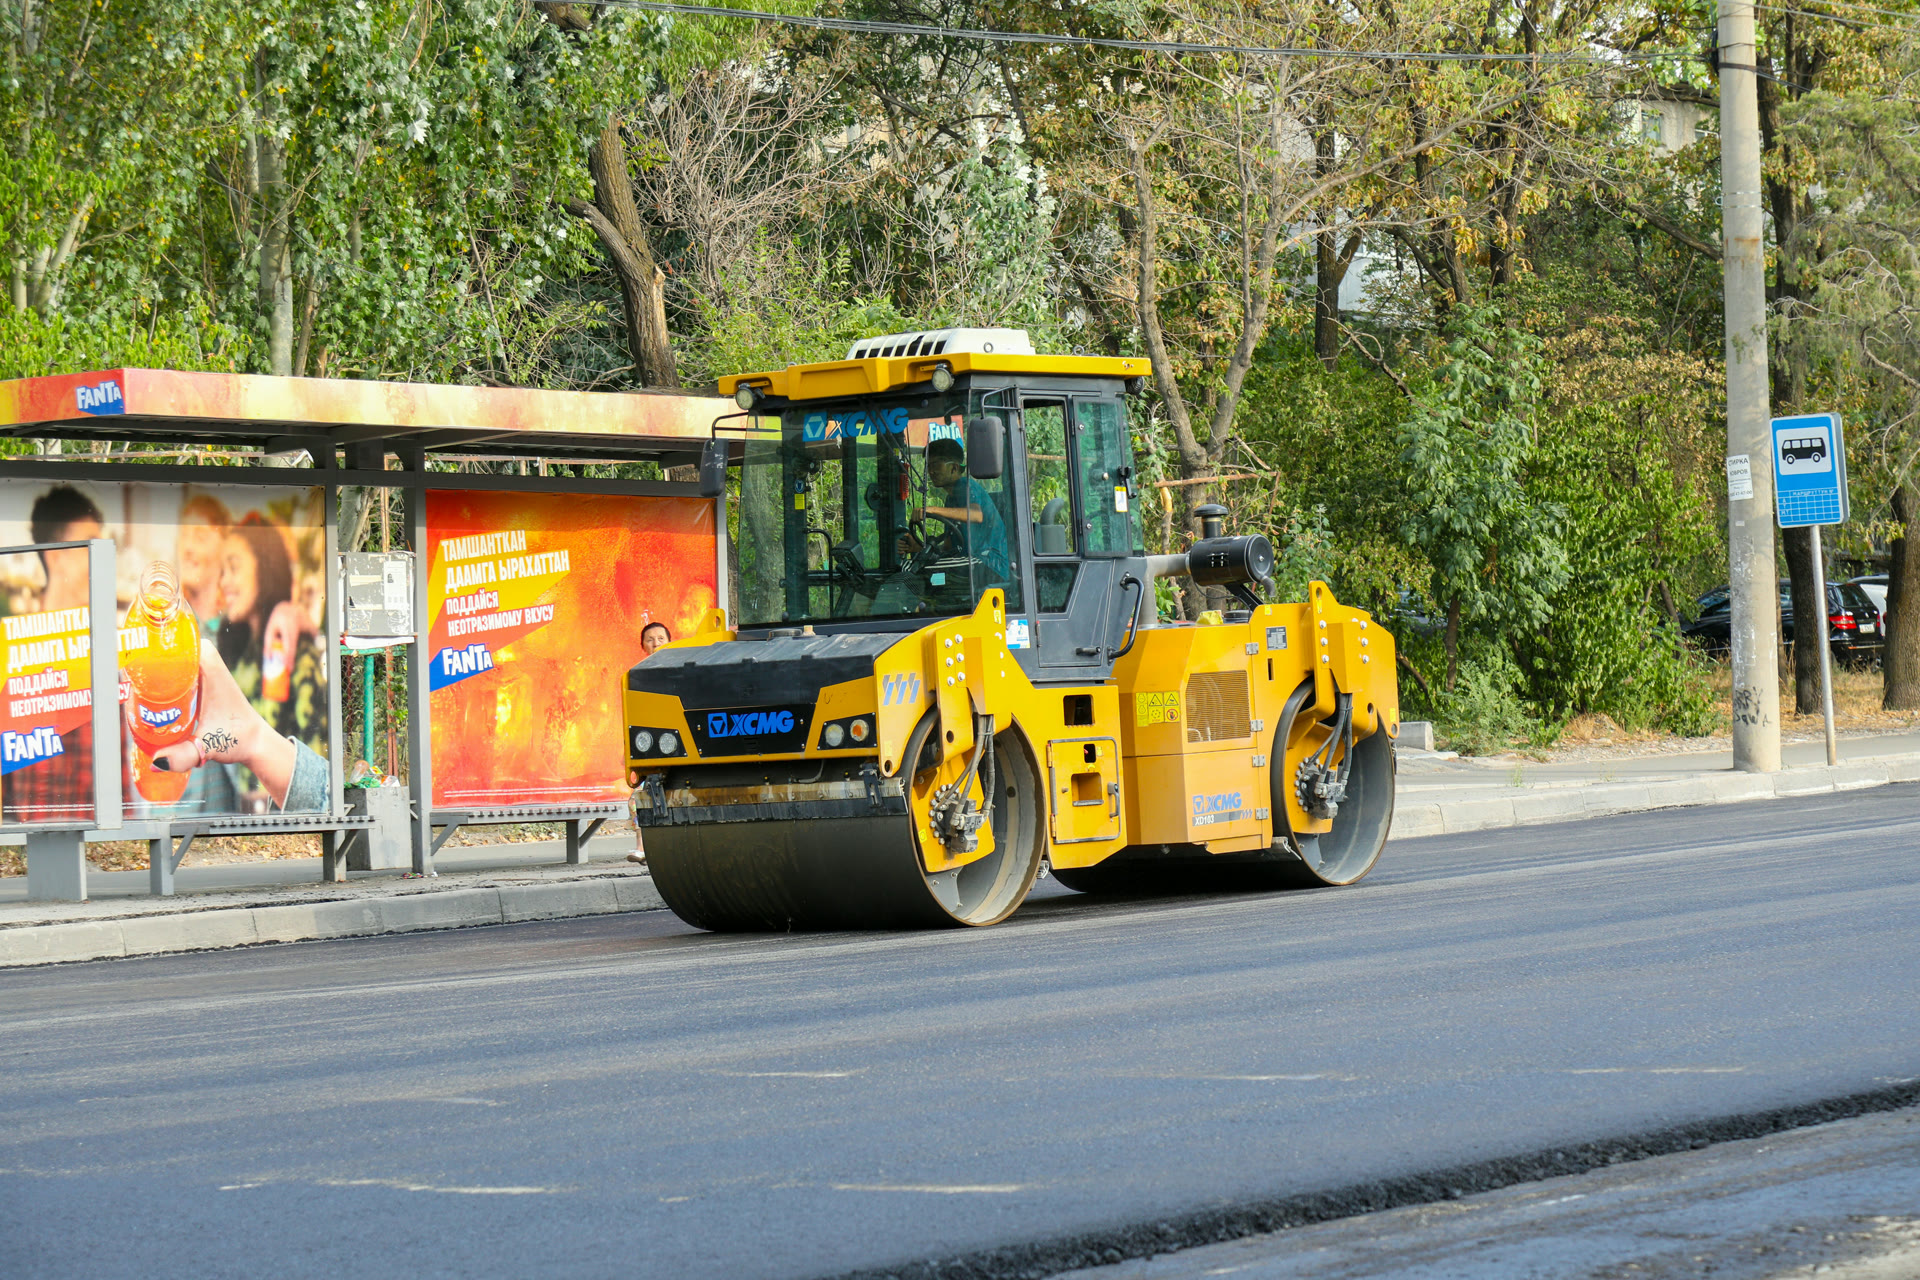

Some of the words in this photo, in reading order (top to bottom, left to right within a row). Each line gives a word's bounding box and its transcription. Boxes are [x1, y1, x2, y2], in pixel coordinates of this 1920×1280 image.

[76, 381, 122, 409] FANTA
[824, 407, 909, 440] XCMG
[928, 421, 962, 442] FANTA
[441, 529, 527, 562] ТАМШАНТКАН
[445, 561, 497, 594] ДААМГА
[498, 549, 570, 581] ЫРАХАТТАН
[445, 589, 499, 616] ПОДДАЙСЯ
[3, 607, 91, 641] ТАМШАНТКА
[447, 609, 523, 637] НЕОТРАЗИМОМУ
[524, 604, 555, 625] ВКУСУ
[7, 638, 66, 674] ДААМГА
[442, 643, 493, 676] FANTA
[8, 667, 69, 697] ПОДДАЙСЯ
[139, 704, 182, 723] FANTA
[728, 710, 795, 737] XCMG
[3, 727, 64, 762] FANTA
[1205, 792, 1242, 813] XCMG
